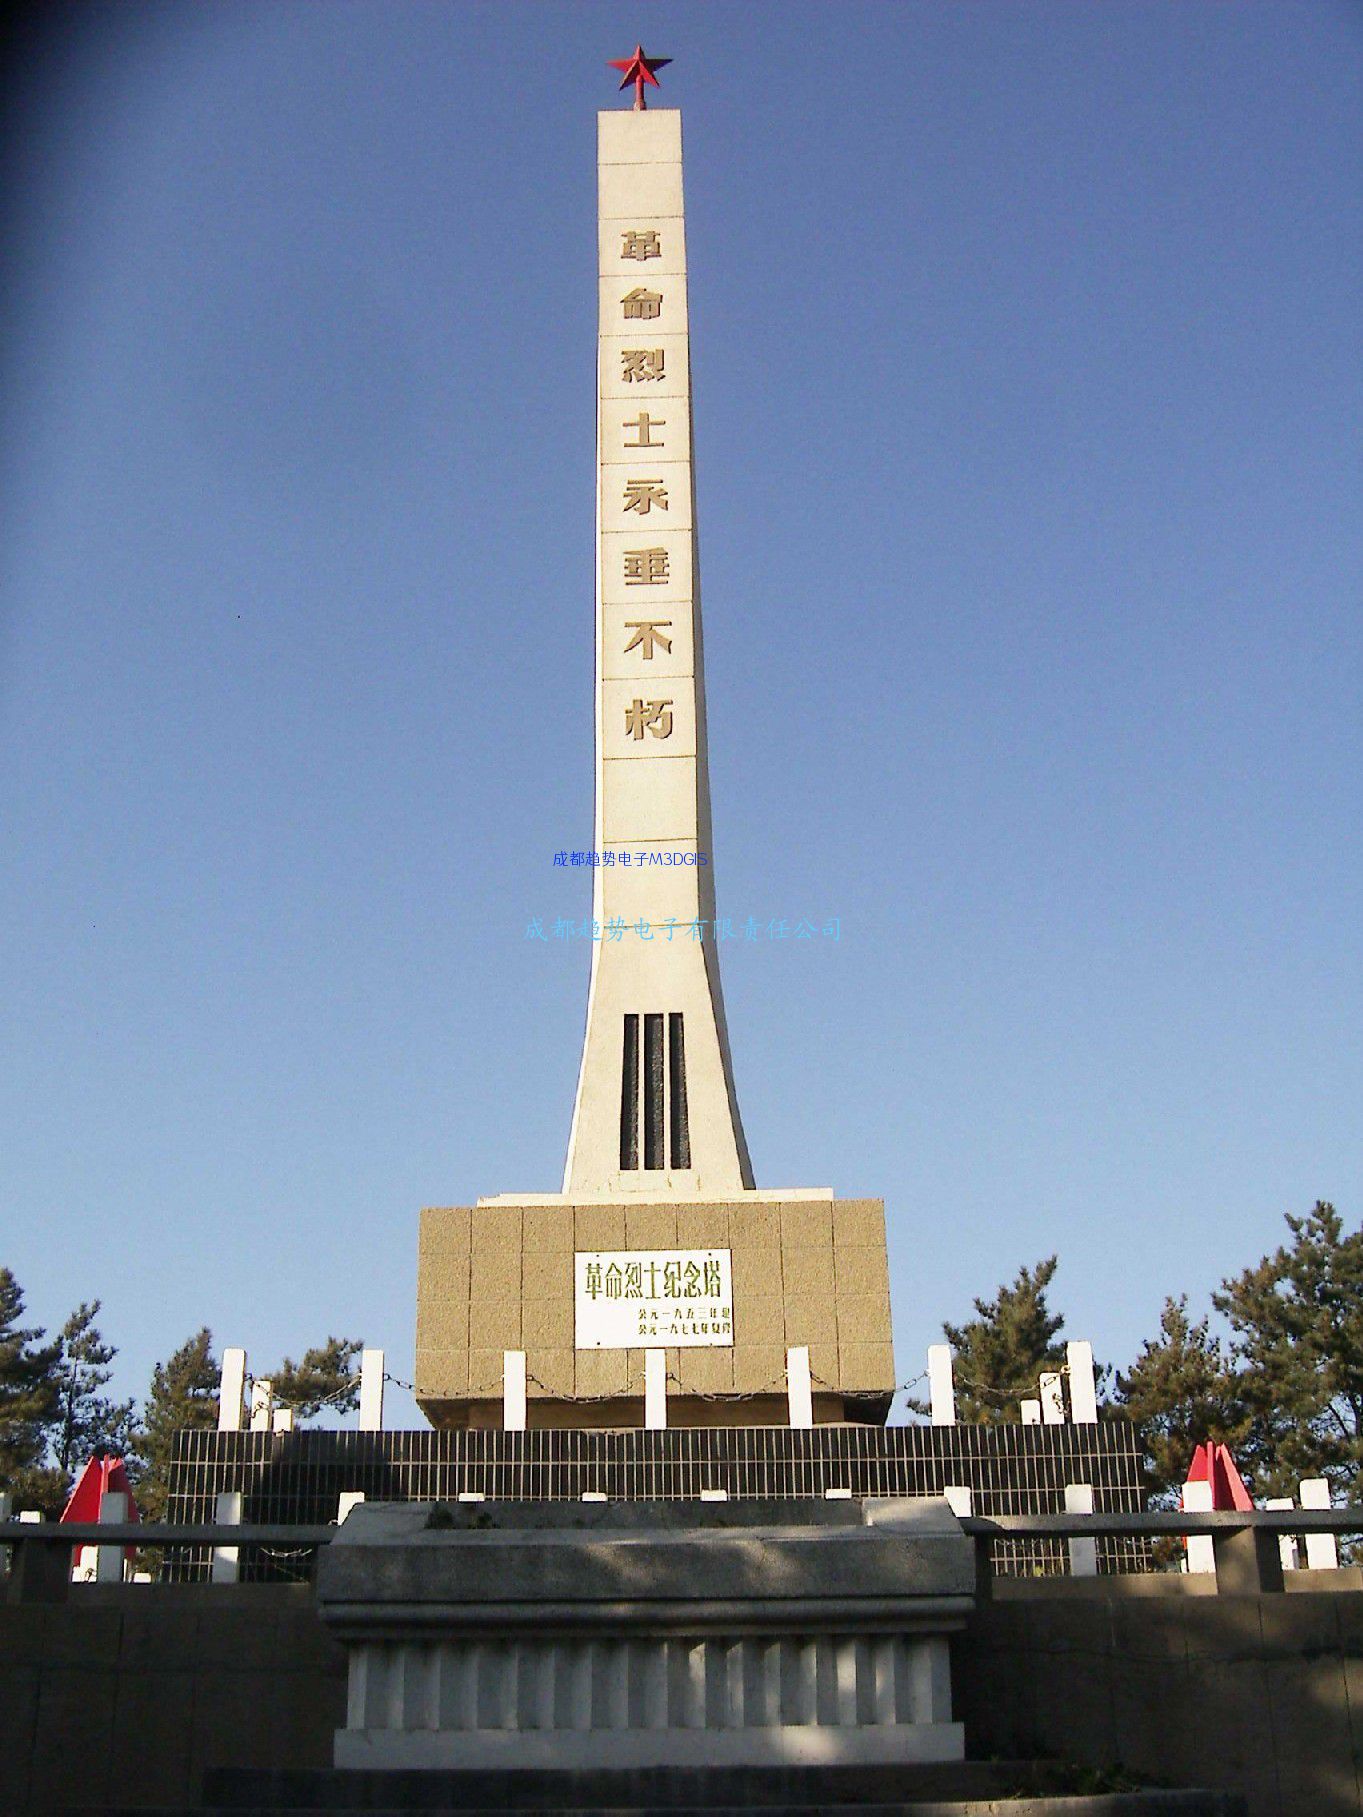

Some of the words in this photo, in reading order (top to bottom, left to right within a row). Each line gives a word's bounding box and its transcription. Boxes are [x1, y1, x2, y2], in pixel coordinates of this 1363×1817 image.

[620, 231, 673, 740] 革命烈士永垂不朽
[585, 1261, 721, 1300] 革命烈士纪念塔
